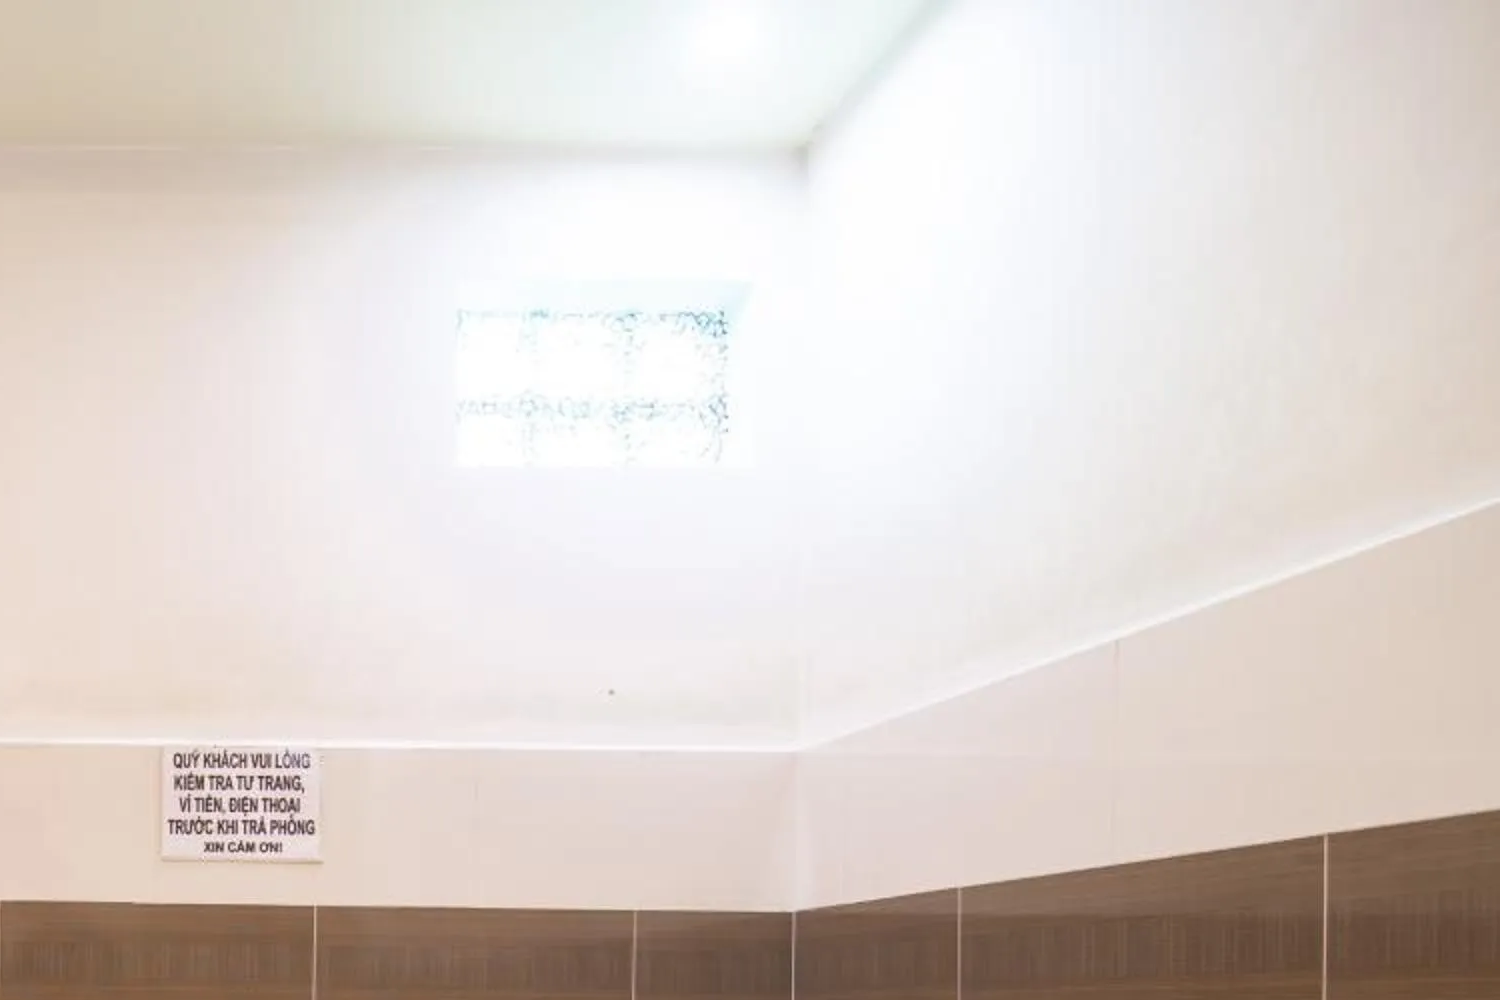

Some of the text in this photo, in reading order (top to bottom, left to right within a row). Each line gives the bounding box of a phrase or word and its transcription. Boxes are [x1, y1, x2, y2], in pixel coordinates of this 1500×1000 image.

[203, 749, 248, 769] KHÁCH
[250, 753, 272, 769] VUI
[275, 748, 311, 769] LÒNG
[208, 775, 234, 790] TRA
[236, 775, 254, 790] TƯ
[258, 775, 305, 794] TRANG,
[229, 795, 258, 817] ĐIỆN
[167, 814, 316, 835] TRƯỚC KHI TRẢ PHÒNG
[203, 841, 225, 853] XIN
[227, 840, 255, 853] CẢM
